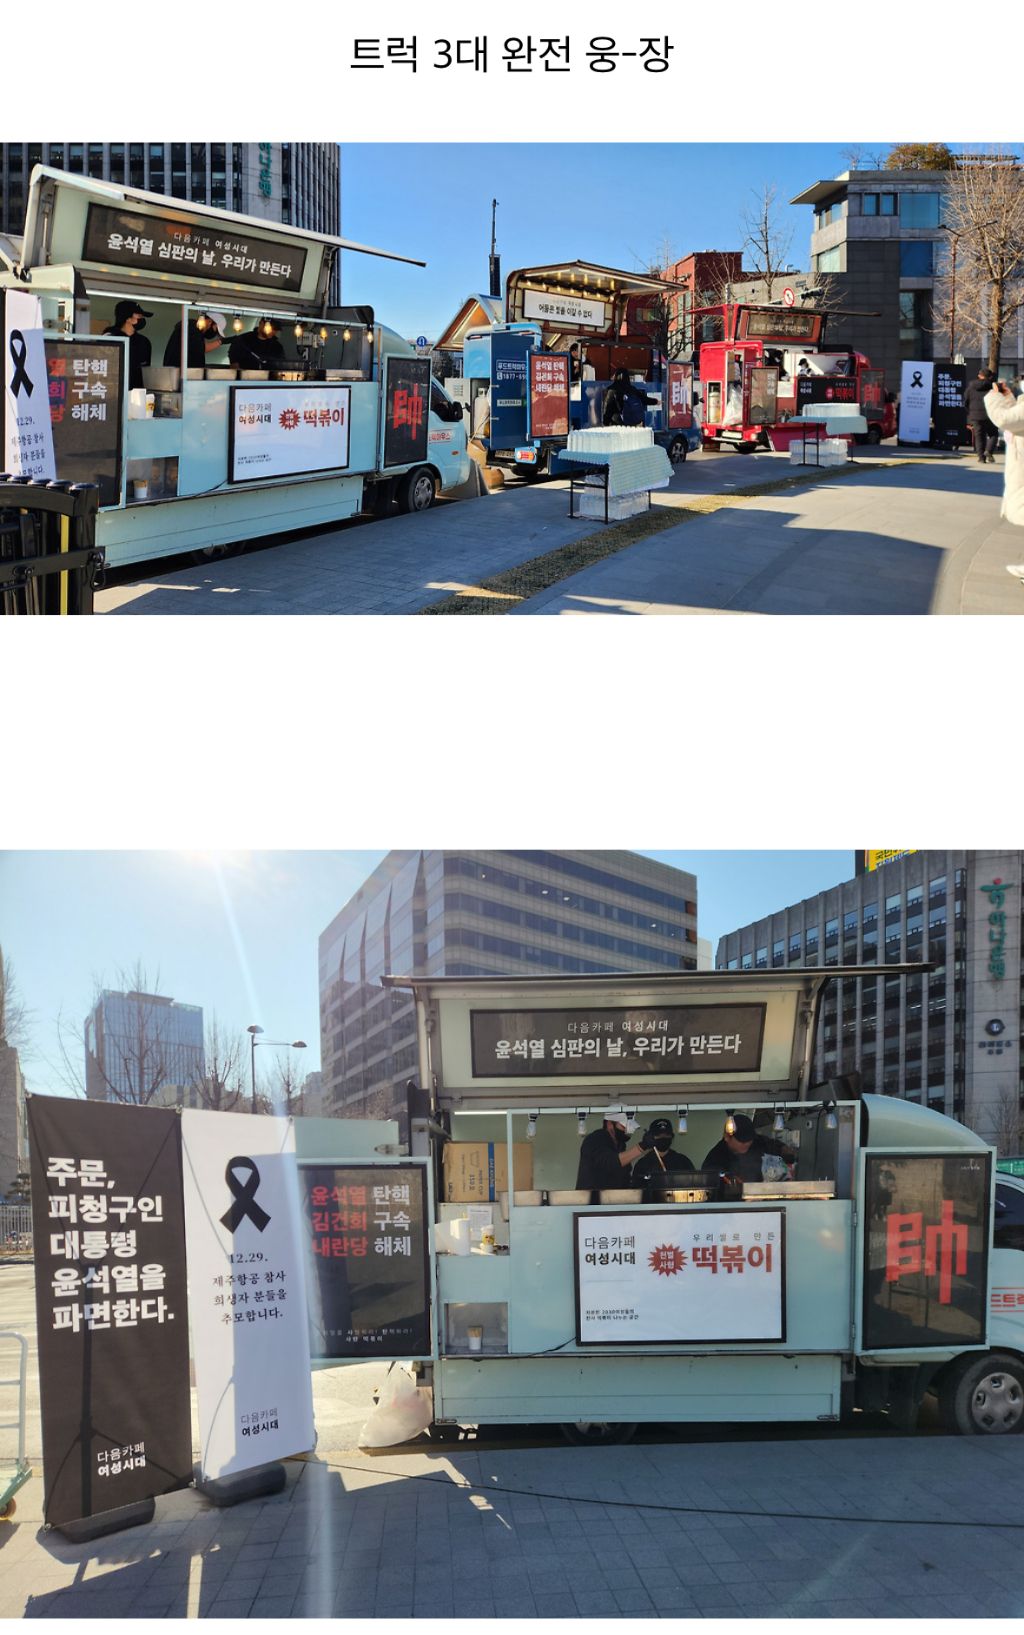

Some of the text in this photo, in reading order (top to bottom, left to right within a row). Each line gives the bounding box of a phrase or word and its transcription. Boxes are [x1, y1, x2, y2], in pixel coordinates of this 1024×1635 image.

[173, 232, 248, 253] 다음카페 여성시대
[107, 233, 292, 279] 윤석열 심판의 날, 우리가 만든다
[72, 358, 108, 377] 탄핵
[71, 381, 108, 399] 구속
[71, 403, 107, 421] 해체
[238, 403, 272, 413] 다음카페
[303, 407, 345, 428] 떡볶이
[238, 414, 272, 425] 여성시대
[567, 1020, 669, 1033] 다음카페 여성시대
[495, 1034, 742, 1059] 윤석열 심판의 날, 우리가 만든다
[46, 1157, 115, 1190] 주문,
[311, 1184, 410, 1206] 윤석열 탄핵
[48, 1193, 164, 1224] 피청구인
[312, 1210, 411, 1232] 김건희 구속
[49, 1229, 138, 1260] 대통령
[311, 1236, 411, 1257] 내란당 해체
[584, 1235, 636, 1250] 다음카페
[229, 1252, 268, 1264] 12.29.
[585, 1252, 636, 1266] 여성시대
[692, 1243, 772, 1274] 떡볶이
[51, 1263, 167, 1298] 윤석열을
[212, 1270, 287, 1287] 제주항공 참사
[214, 1288, 287, 1306] 희생자 분들을
[52, 1296, 175, 1333] 파면한다.
[221, 1307, 283, 1325] 추모합니다.
[240, 1407, 278, 1425] 다음카페
[241, 1419, 279, 1437] 여성시대
[97, 1441, 145, 1463] 다음카페
[97, 1455, 146, 1478] 여성시대
